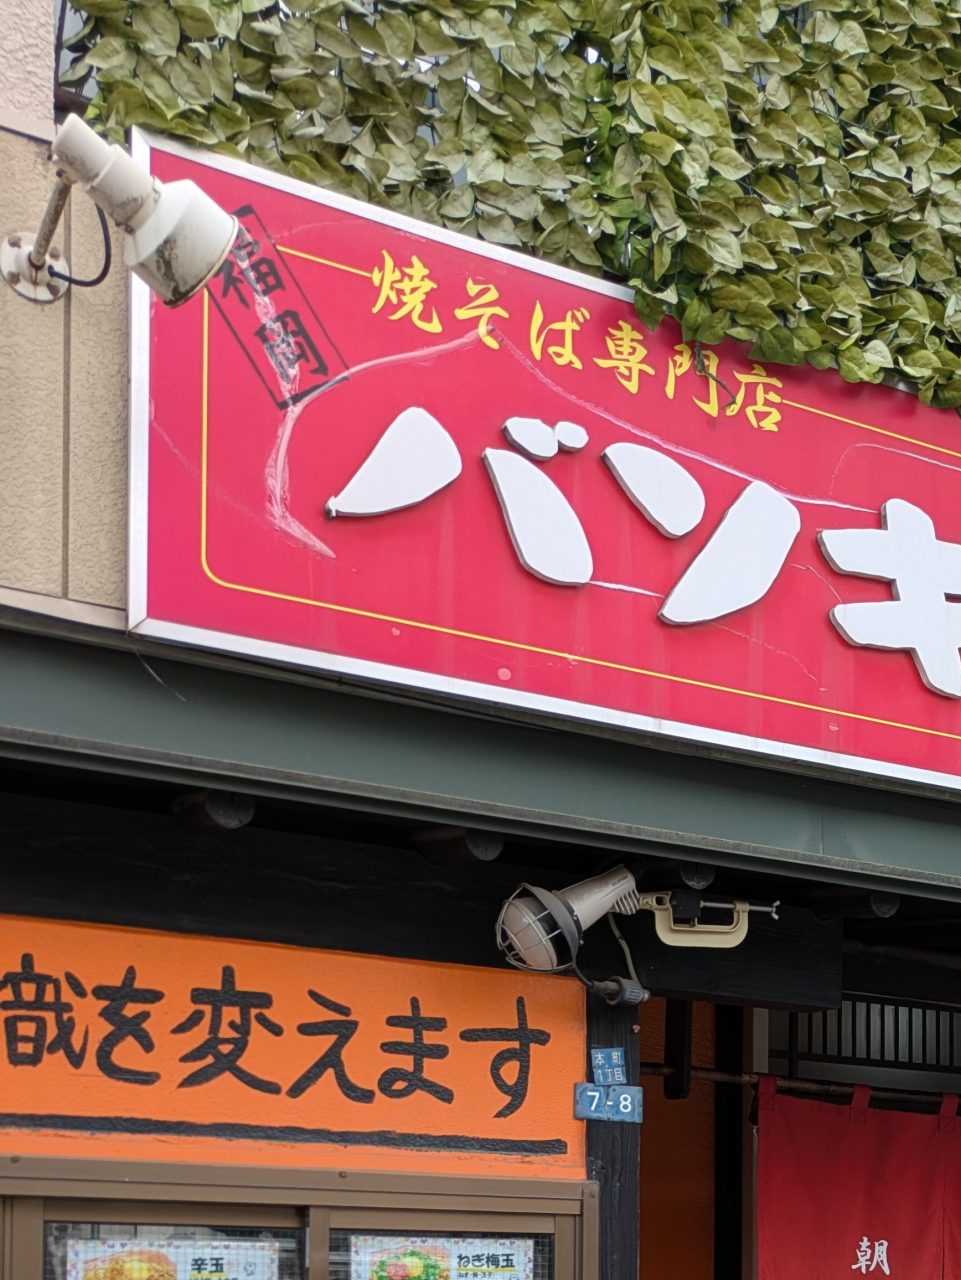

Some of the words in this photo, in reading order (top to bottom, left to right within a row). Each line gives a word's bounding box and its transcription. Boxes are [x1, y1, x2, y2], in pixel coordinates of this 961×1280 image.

[371, 249, 786, 432] 焼そば専門店
[597, 1067, 623, 1083] 1丁目
[587, 1091, 632, 1113] 7-8
[190, 1256, 224, 1274] 辛玉
[457, 1252, 515, 1269] ねぎ梅玉
